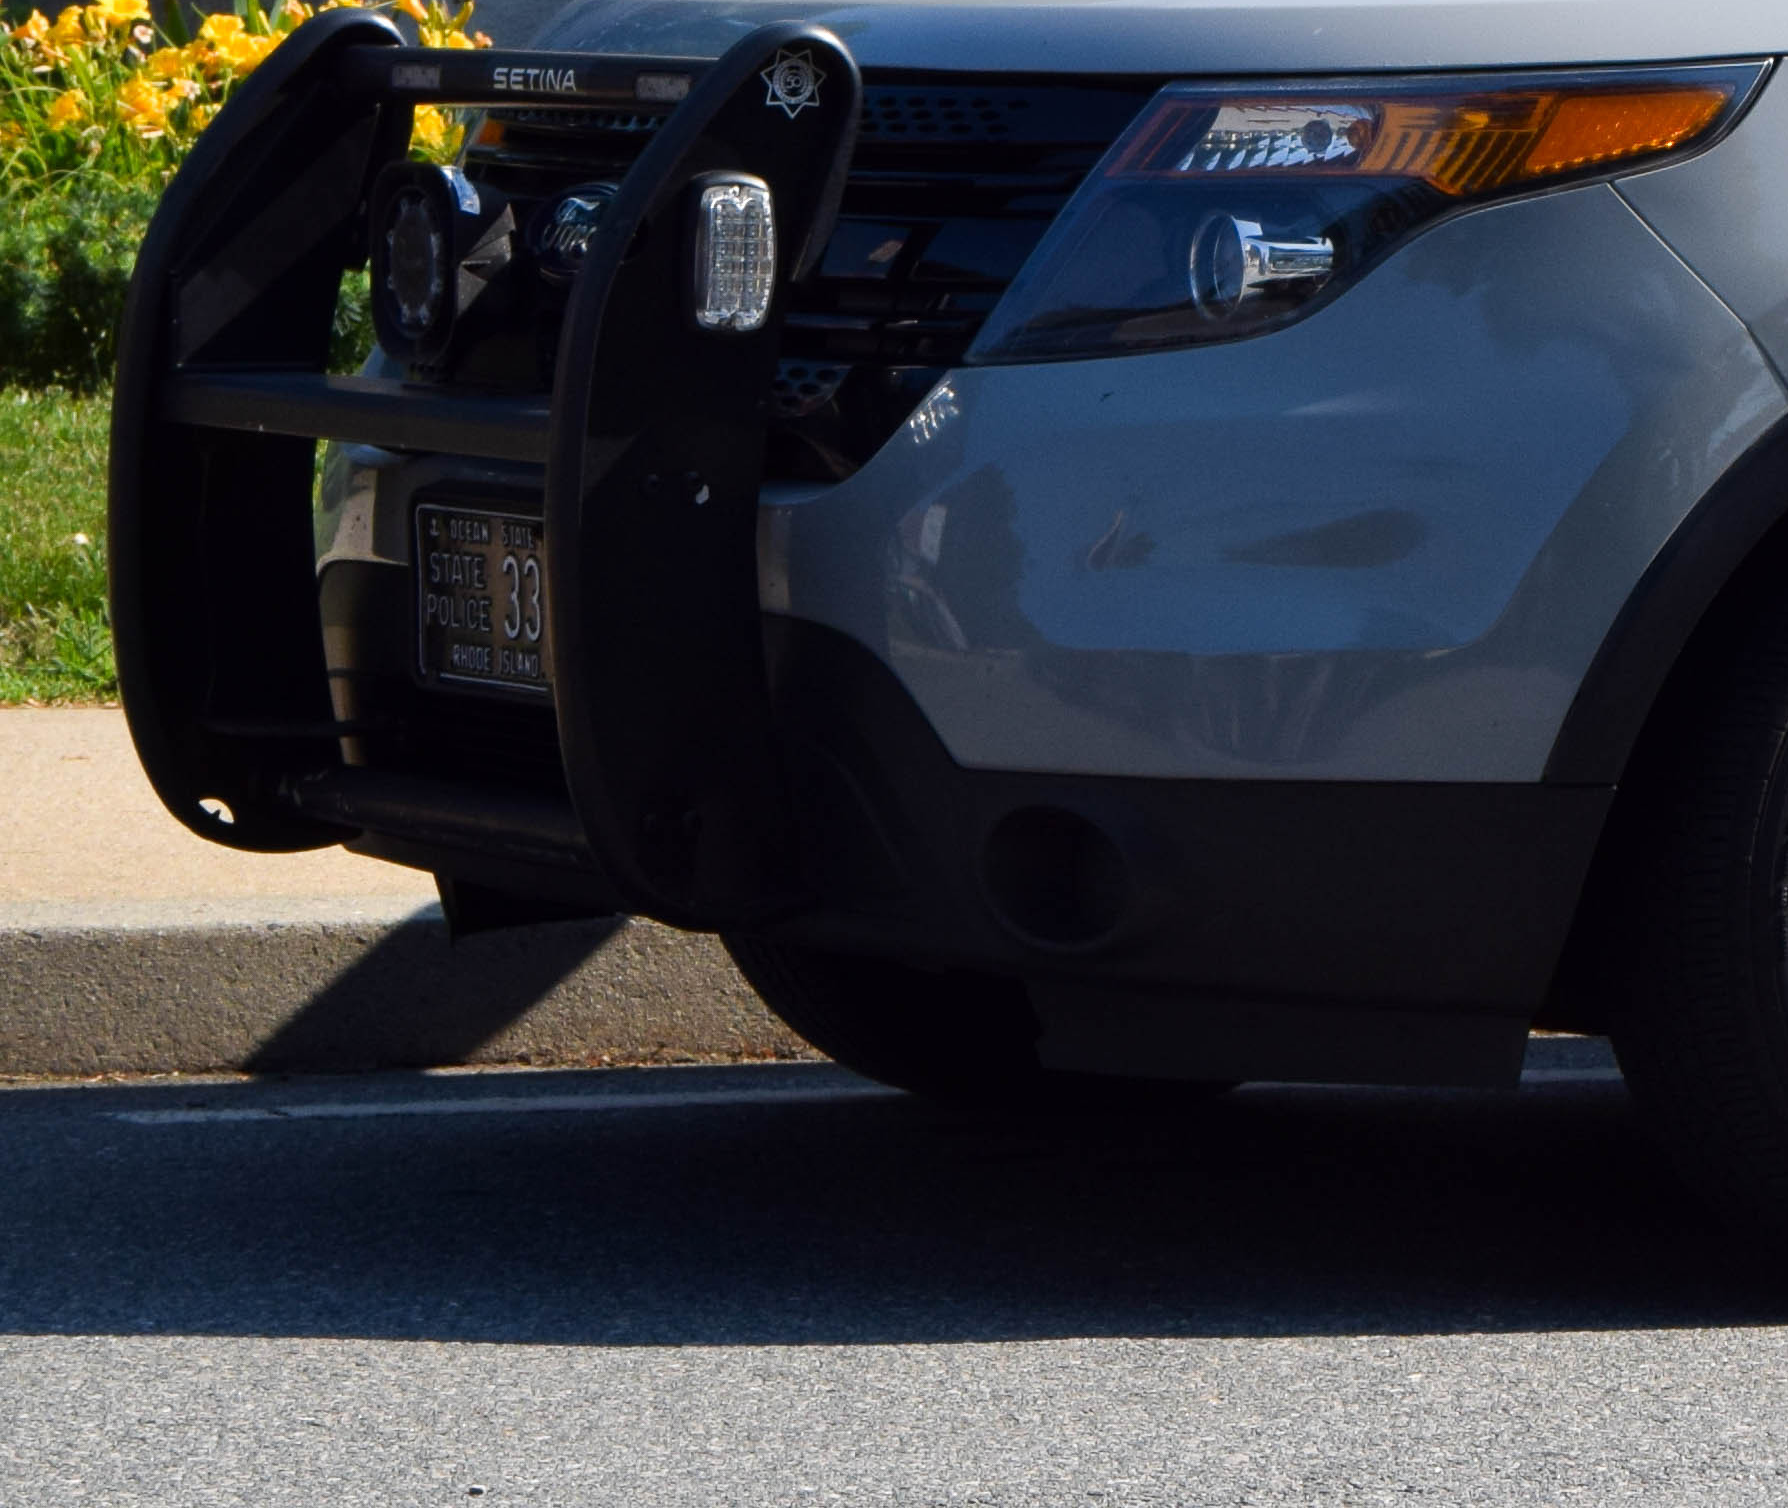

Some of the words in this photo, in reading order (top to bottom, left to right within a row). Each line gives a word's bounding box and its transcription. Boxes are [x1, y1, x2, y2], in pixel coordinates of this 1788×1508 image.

[493, 67, 577, 92] SETINA
[450, 518, 489, 542] OCEAN
[502, 524, 534, 549] STATE
[429, 552, 485, 589] STATE
[425, 593, 492, 632] POLICE
[502, 554, 542, 642] 33
[452, 644, 492, 671] RHODE
[498, 649, 539, 678] ISLAND
